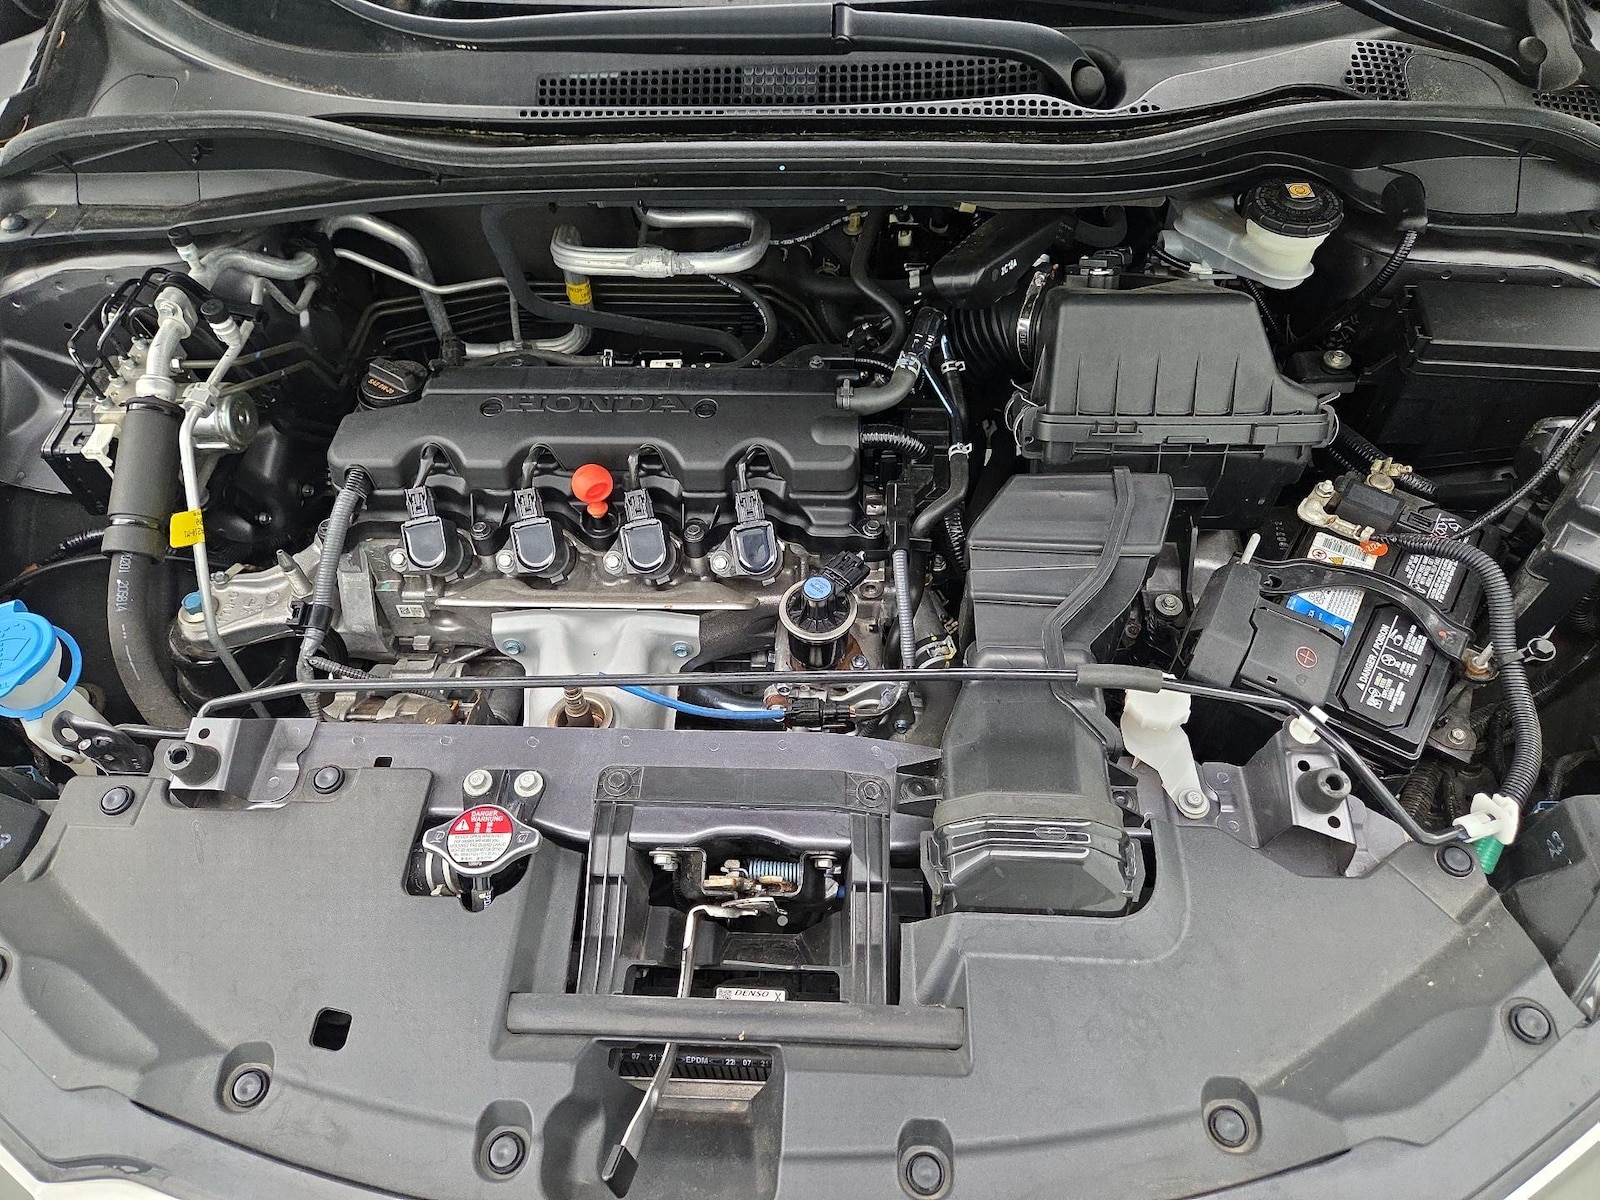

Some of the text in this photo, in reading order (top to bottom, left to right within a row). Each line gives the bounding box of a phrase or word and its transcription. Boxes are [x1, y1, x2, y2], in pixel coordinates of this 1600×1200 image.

[504, 394, 691, 414] HONDA
[1358, 653, 1377, 684] DANGER
[1372, 623, 1391, 651] POISON
[734, 989, 770, 998] DENSO
[631, 1052, 641, 1061] 07
[742, 1059, 752, 1067] 07
